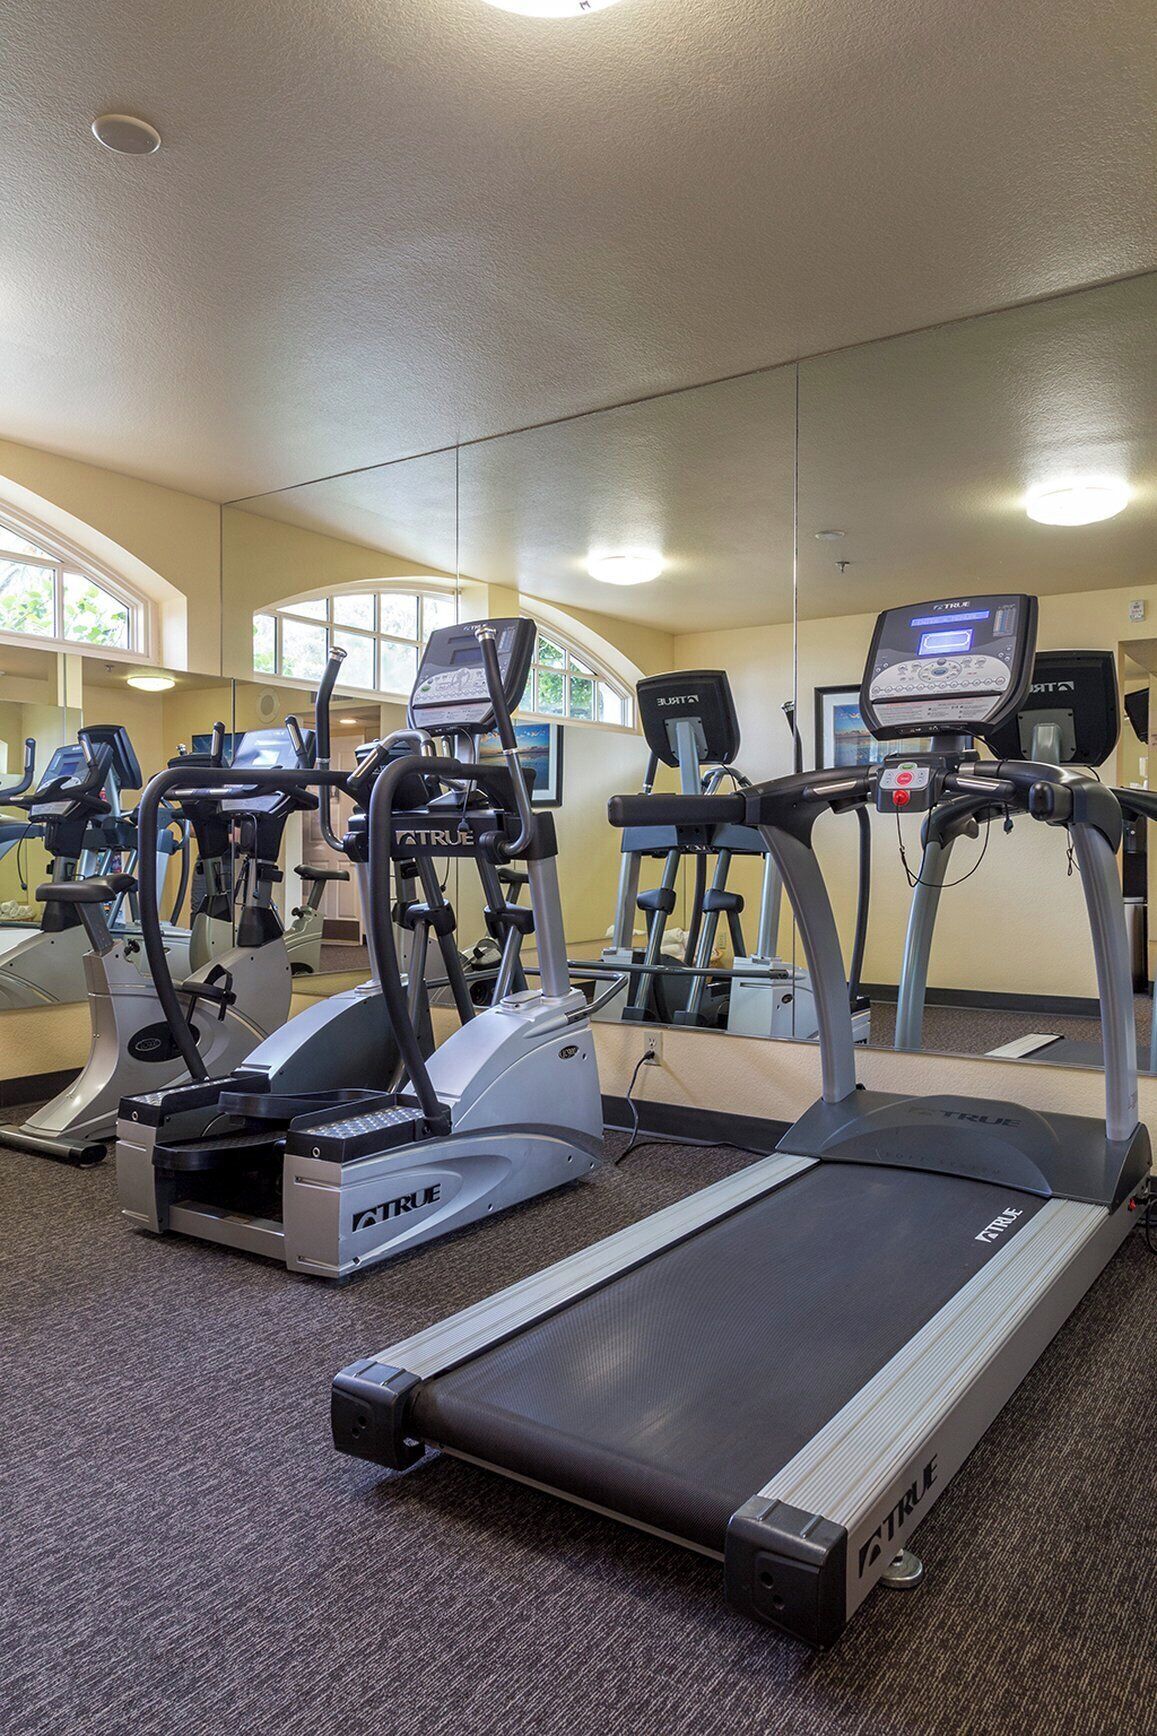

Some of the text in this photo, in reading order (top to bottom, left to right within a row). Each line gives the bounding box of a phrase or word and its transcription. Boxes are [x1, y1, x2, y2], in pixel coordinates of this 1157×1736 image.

[415, 830, 474, 845] TRUE
[940, 1110, 1023, 1128] TRUE
[377, 1183, 441, 1221] TRUE
[882, 1453, 938, 1541] TRUE
